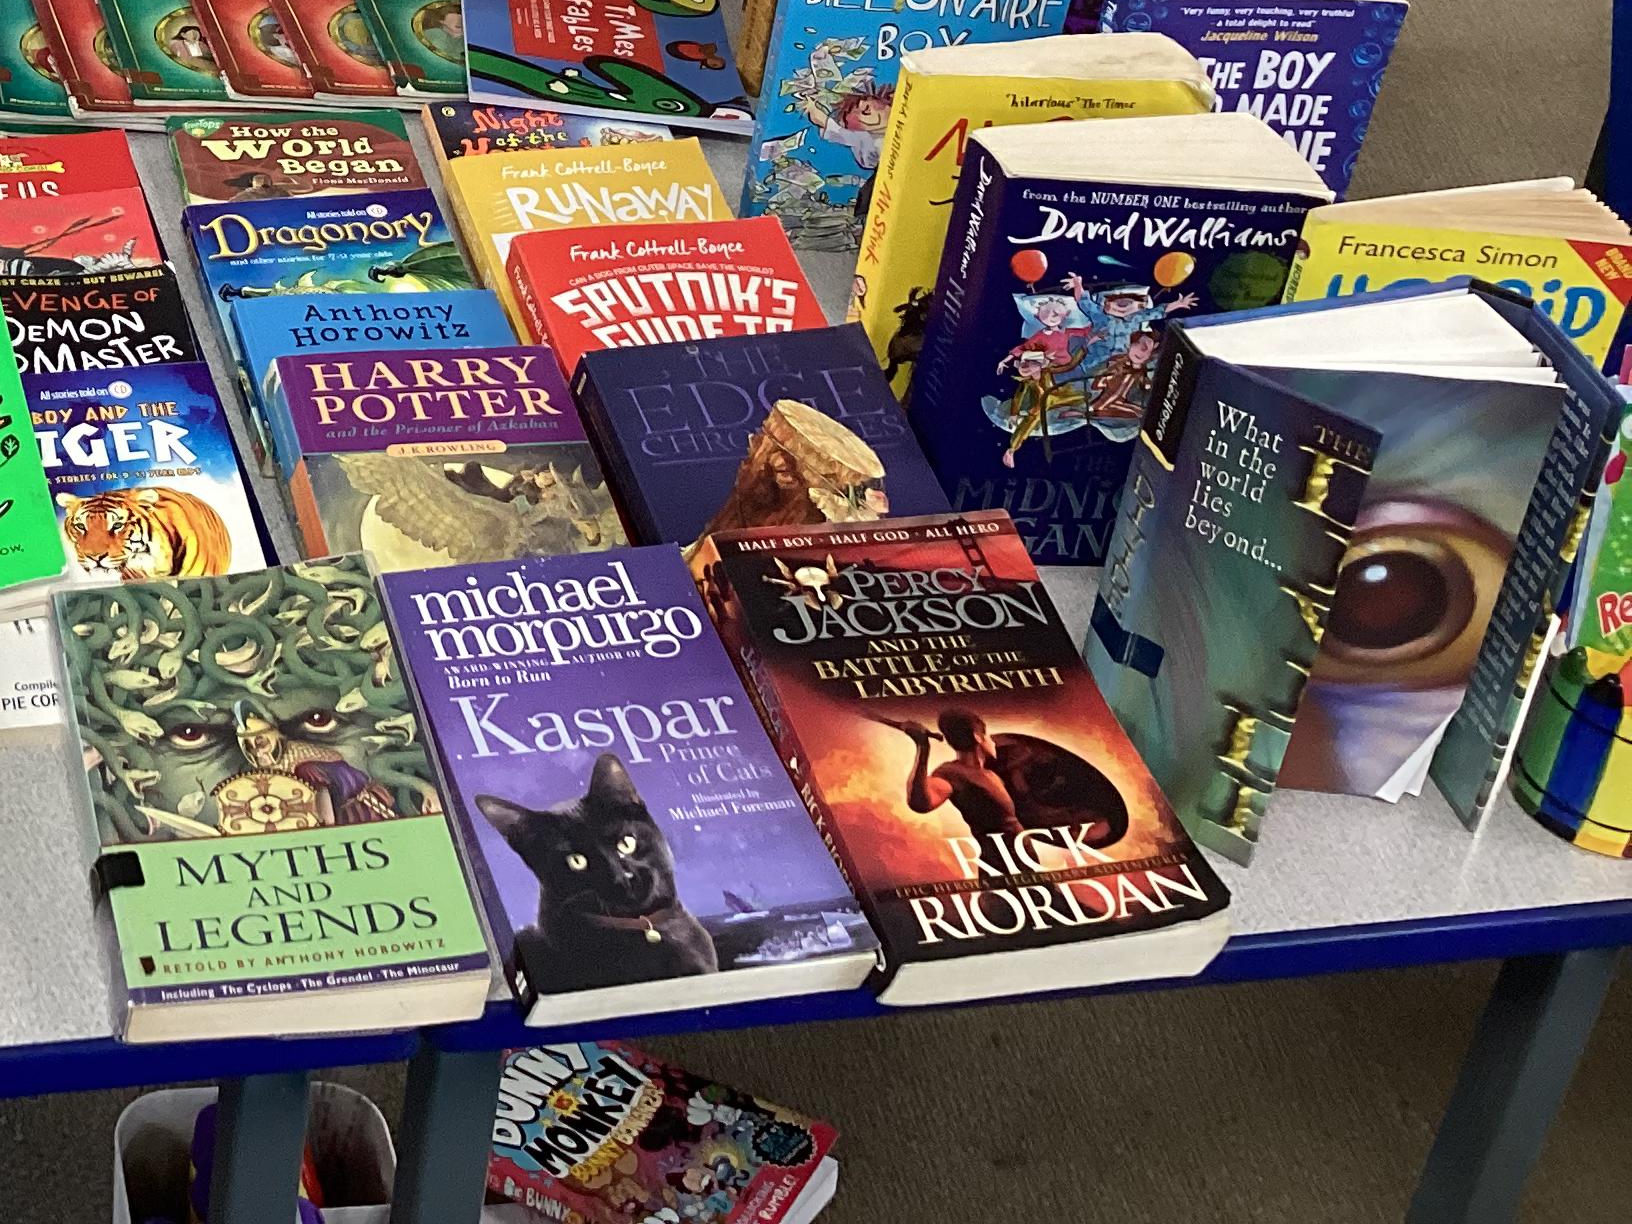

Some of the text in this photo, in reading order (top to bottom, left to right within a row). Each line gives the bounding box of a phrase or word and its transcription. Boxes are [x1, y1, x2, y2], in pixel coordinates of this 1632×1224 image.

[1201, 31, 1318, 44] Jacqueline Wilson
[201, 138, 373, 161] World
[230, 125, 338, 138] How the
[277, 158, 402, 177] Began
[1023, 189, 1309, 214] from the NUMBER ONE bestselling author
[200, 212, 433, 259] Dragonory
[1009, 207, 1298, 250] David Walliams
[570, 238, 744, 262] Frank Cottrell-Boyce
[1338, 236, 1558, 269] Francesca Simon
[305, 304, 454, 322] Anthony
[551, 273, 798, 325] SPUTNIK'S
[290, 322, 470, 348] Horowitz
[306, 356, 537, 392] HARRY
[311, 387, 562, 425] POTTER
[326, 419, 559, 439] and the Prisoner of Azkaban
[1217, 401, 1284, 453] What
[1205, 430, 1277, 479] in the
[1194, 481, 1233, 516] lies
[1201, 462, 1267, 503] world
[1186, 506, 1283, 571] beyond...
[410, 561, 647, 625] michael
[847, 565, 987, 601] PERCY
[772, 583, 1049, 645] JACKSON
[424, 606, 702, 664] morpurgo
[448, 671, 551, 690] Born to Run
[811, 649, 1024, 680] BATTLE OF THE
[857, 667, 1065, 699] LABYRINTH
[450, 692, 737, 763] Kaspar
[659, 742, 739, 763] Prince
[687, 763, 771, 786] of Cats
[669, 797, 795, 822] Michael Foreman
[176, 838, 390, 887] MYTHS
[947, 822, 1114, 879] RICK
[246, 881, 332, 908] AND
[910, 864, 1208, 945] RIORDAN
[156, 896, 438, 954] LEGENDS
[164, 938, 446, 973] RETOLD BY ANTHONY HOROWITZ
[161, 961, 459, 1001] Including The Cyclops The Grendel The Minotaur
[524, 1054, 649, 1177] MONKEY
